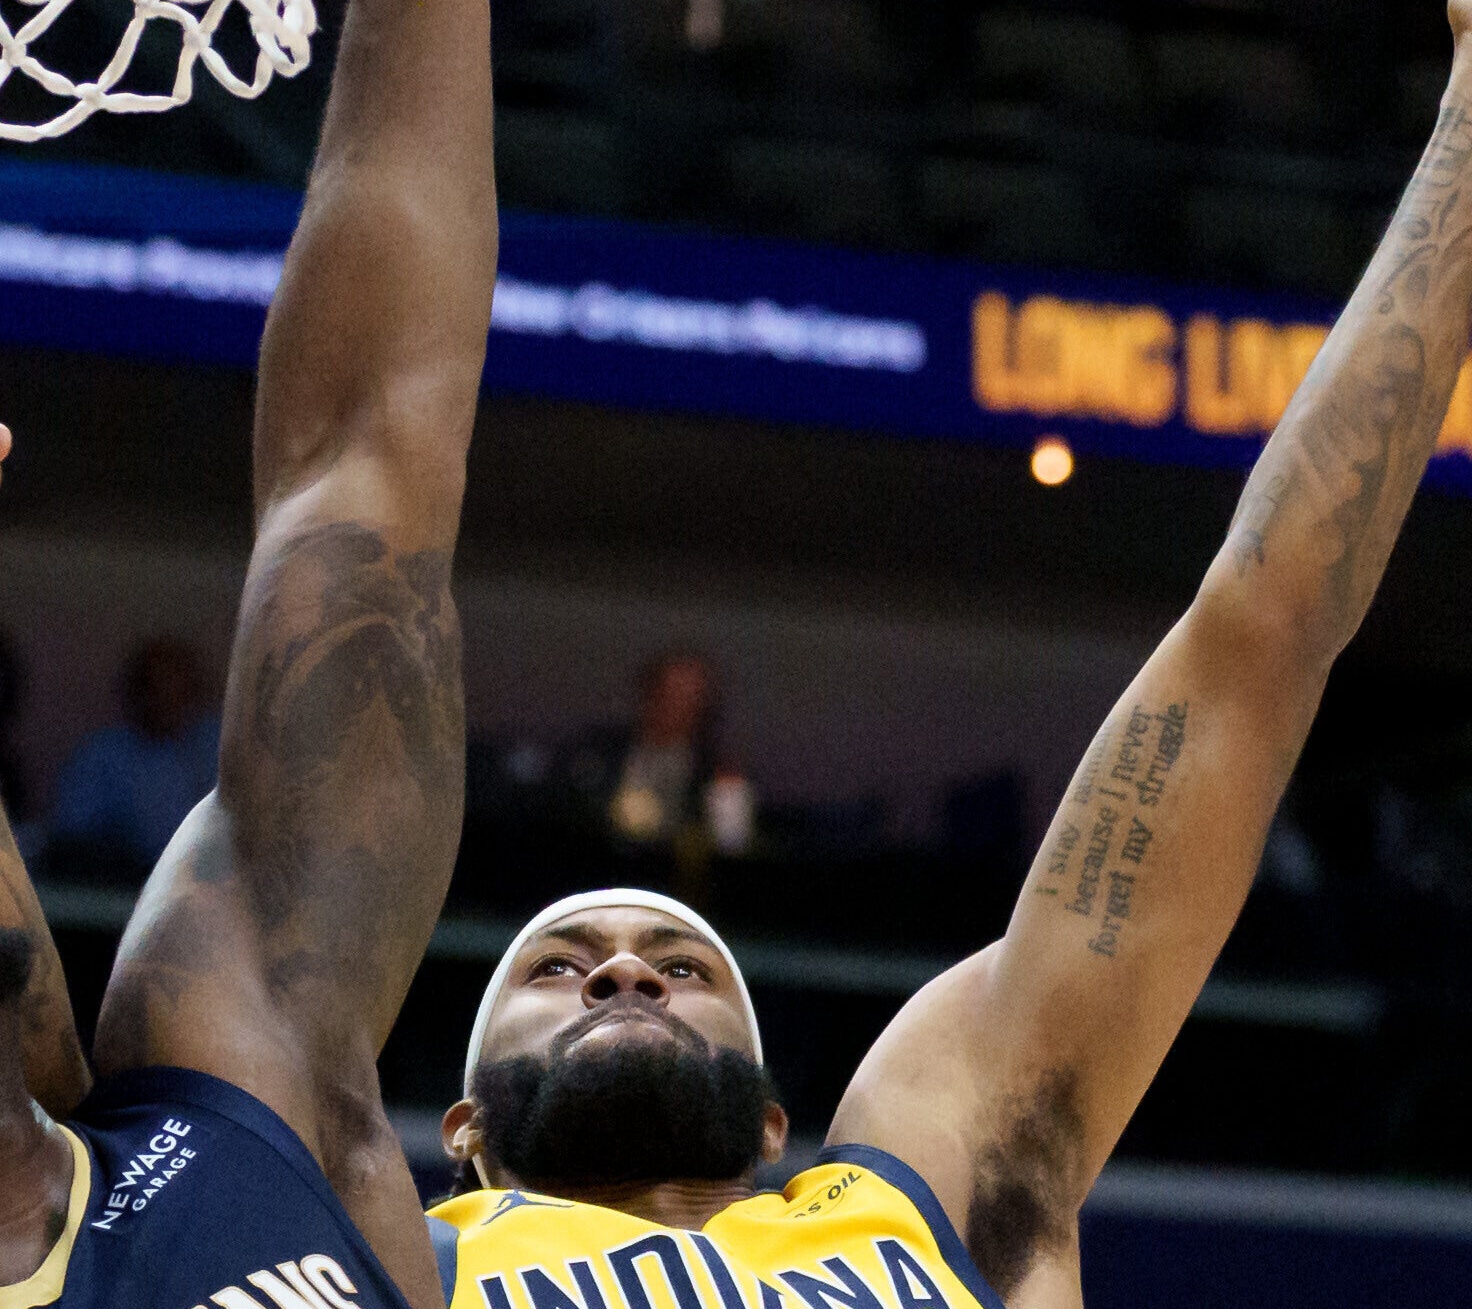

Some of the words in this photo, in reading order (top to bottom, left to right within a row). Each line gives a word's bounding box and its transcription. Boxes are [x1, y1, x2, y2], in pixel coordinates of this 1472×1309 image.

[978, 300, 1173, 419] LONG
[1065, 805, 1119, 916] because
[1111, 704, 1152, 784] never
[1088, 871, 1136, 958] forget
[1121, 814, 1153, 864] my
[91, 1118, 192, 1230] NEWAGE
[132, 1147, 197, 1211] GARAGE
[827, 1171, 862, 1200] OIL
